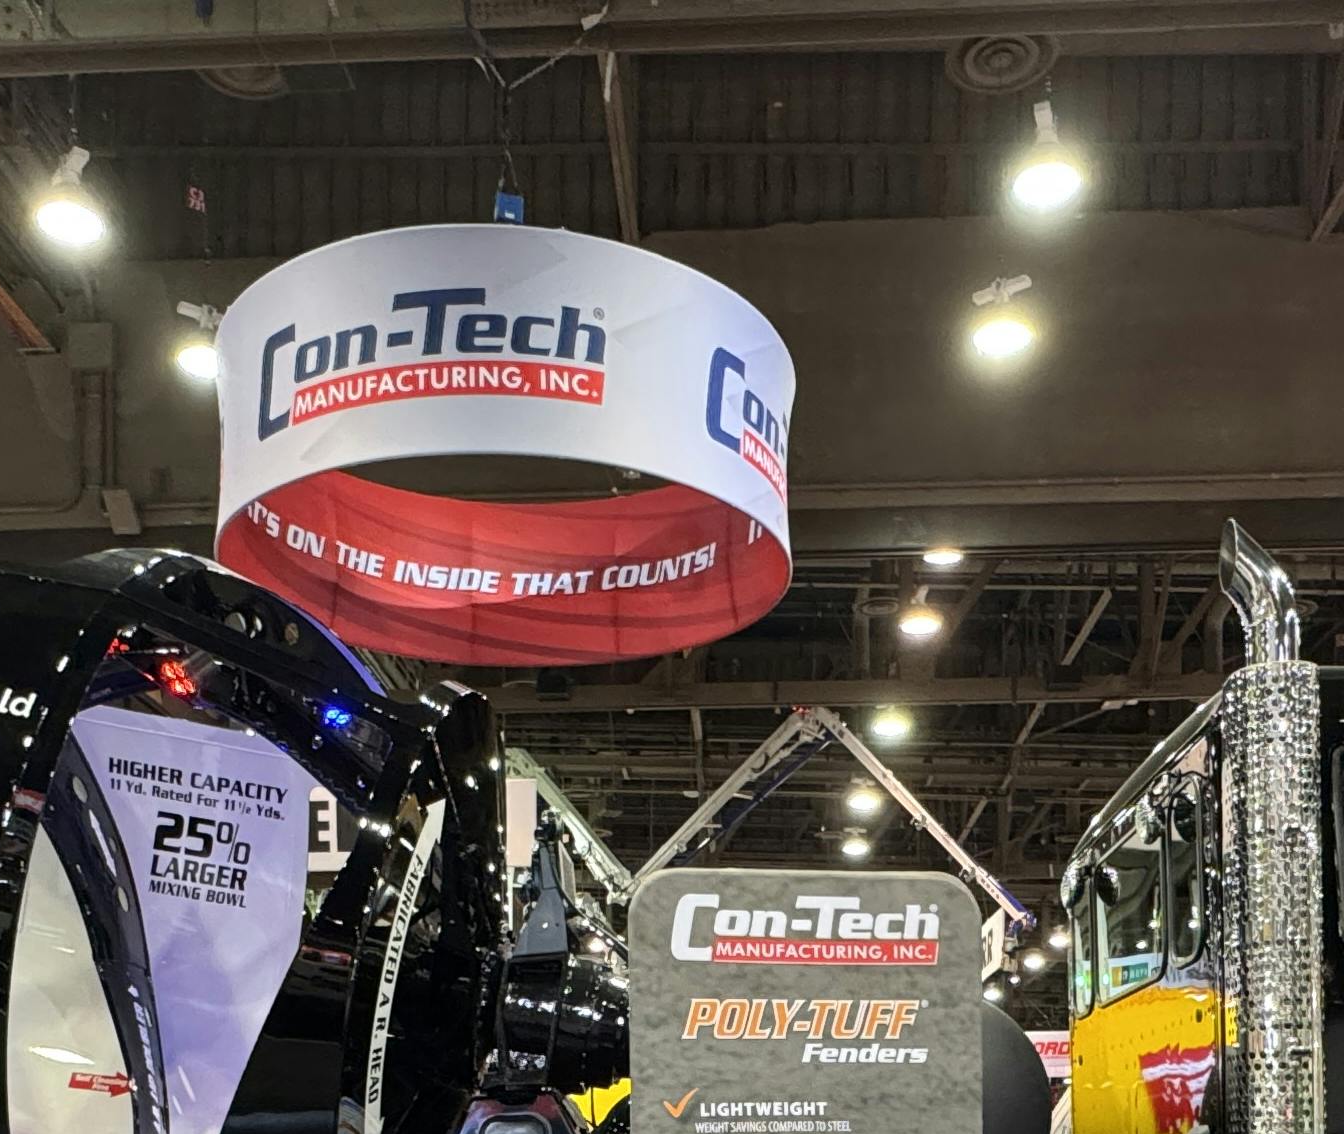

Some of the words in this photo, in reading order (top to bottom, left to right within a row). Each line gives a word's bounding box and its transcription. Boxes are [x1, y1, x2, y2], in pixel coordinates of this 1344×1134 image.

[258, 288, 606, 441] Con-Tech
[294, 366, 532, 417] MANUFACTURING,
[539, 368, 599, 397] INC.
[287, 524, 325, 559] ON
[336, 541, 385, 579] THE
[393, 560, 501, 594] INSIDE
[511, 571, 594, 596] THAT
[601, 543, 717, 591] COUNTS!
[108, 757, 183, 786] HIGHER
[190, 772, 288, 804] CAPACITY
[110, 778, 122, 790] 11
[125, 780, 147, 796] Yd.
[151, 786, 193, 804] Rated
[197, 795, 218, 809] For
[256, 804, 286, 821] Yds.
[153, 811, 252, 865] 25%
[149, 880, 201, 901] MIXING
[205, 890, 247, 909] BOWL
[150, 854, 248, 892] LARGER
[383, 853, 424, 984] FABRICATED
[671, 893, 940, 961] Con-Tech
[716, 941, 887, 961] MANUFACTURING,
[893, 944, 933, 959] INC.
[681, 998, 919, 1040] POLY-TUFF
[801, 1043, 929, 1064] Fenders
[368, 1048, 383, 1105] HEAD
[695, 1121, 729, 1134] WEIGHT
[730, 1121, 767, 1133] SAVINGS
[768, 1121, 814, 1132] COMPARED
[815, 1121, 826, 1132] TO
[827, 1120, 851, 1132] STEEL
[699, 1101, 828, 1117] LIGHTWEIGHT
